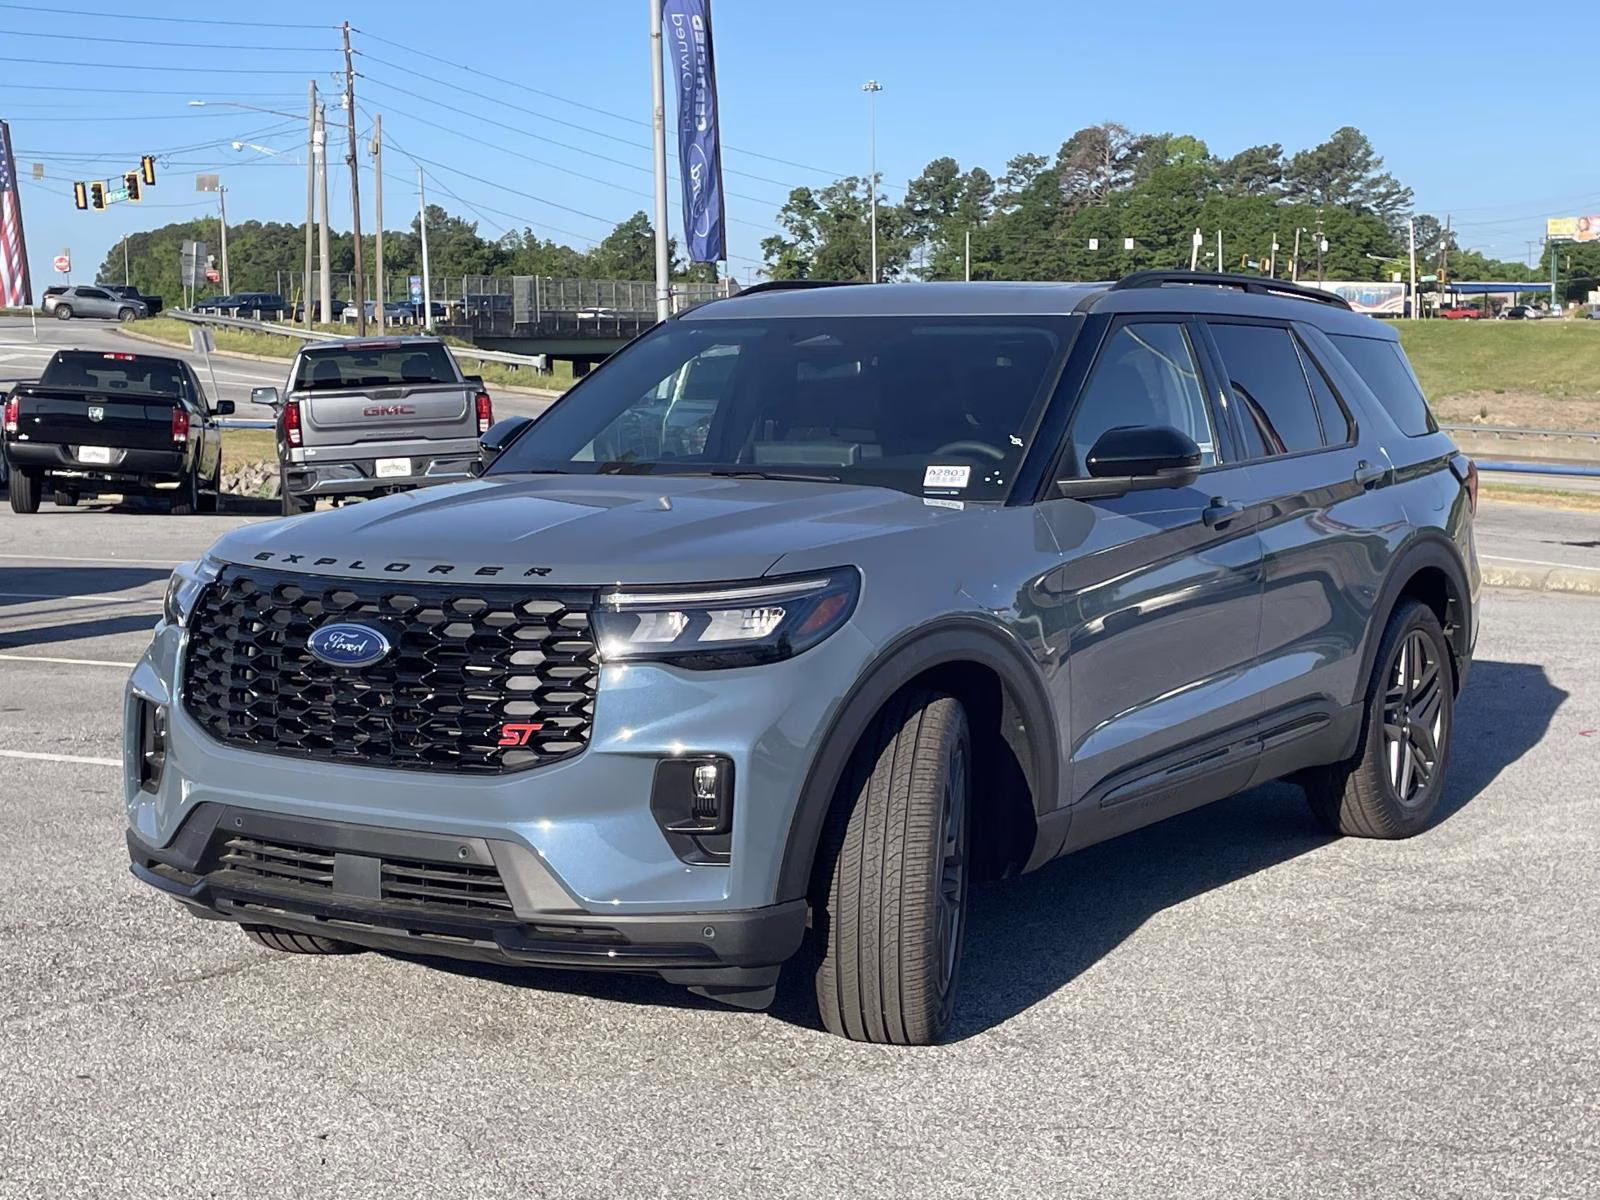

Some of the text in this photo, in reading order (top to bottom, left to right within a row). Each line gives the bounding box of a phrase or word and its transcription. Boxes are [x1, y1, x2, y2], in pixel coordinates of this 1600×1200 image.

[363, 405, 416, 417] GMC
[253, 551, 553, 578] EXPLORER
[323, 632, 369, 653] Ford
[499, 722, 543, 746] ST
